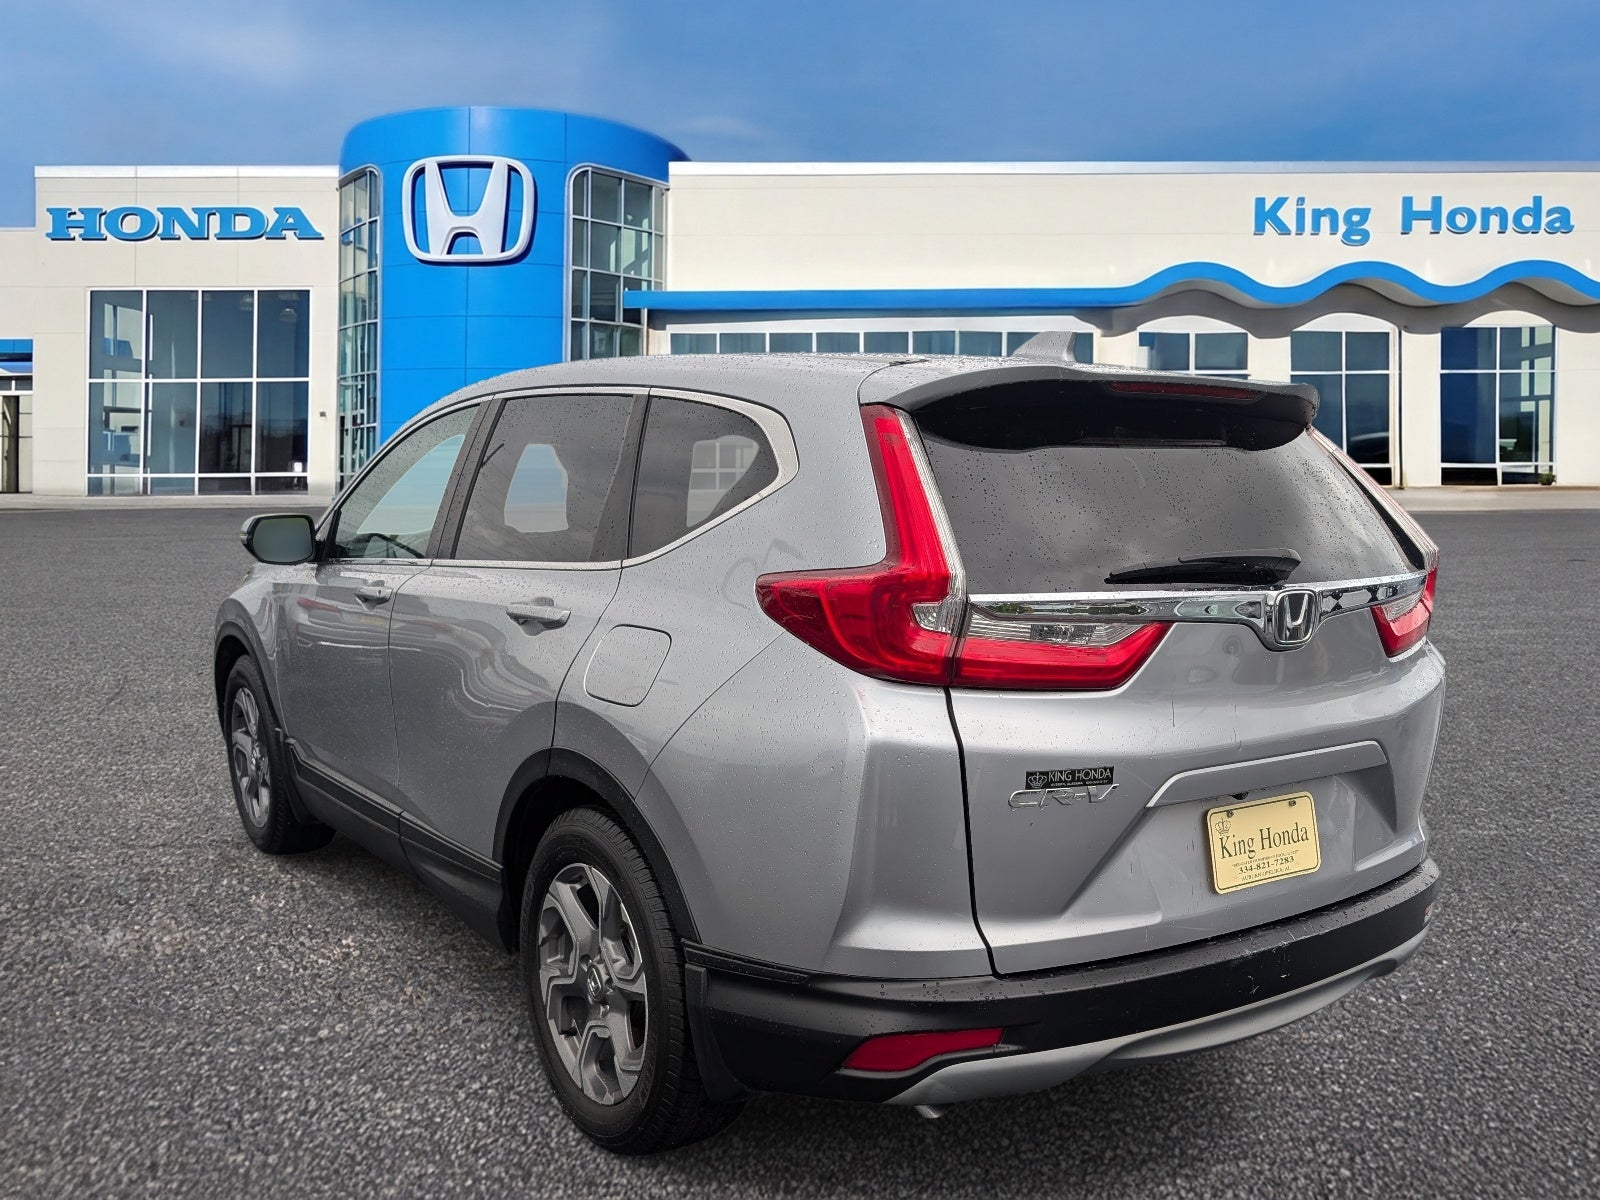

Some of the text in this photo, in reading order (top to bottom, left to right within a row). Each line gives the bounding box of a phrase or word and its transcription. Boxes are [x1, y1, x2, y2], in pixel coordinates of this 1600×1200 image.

[45, 206, 324, 242] HONDA
[1253, 195, 1574, 246] King Honda
[1048, 768, 1111, 782] KING HONDA
[1219, 834, 1256, 859] King
[1259, 821, 1309, 850] Honda
[1238, 855, 1294, 875] 334-821-7283
